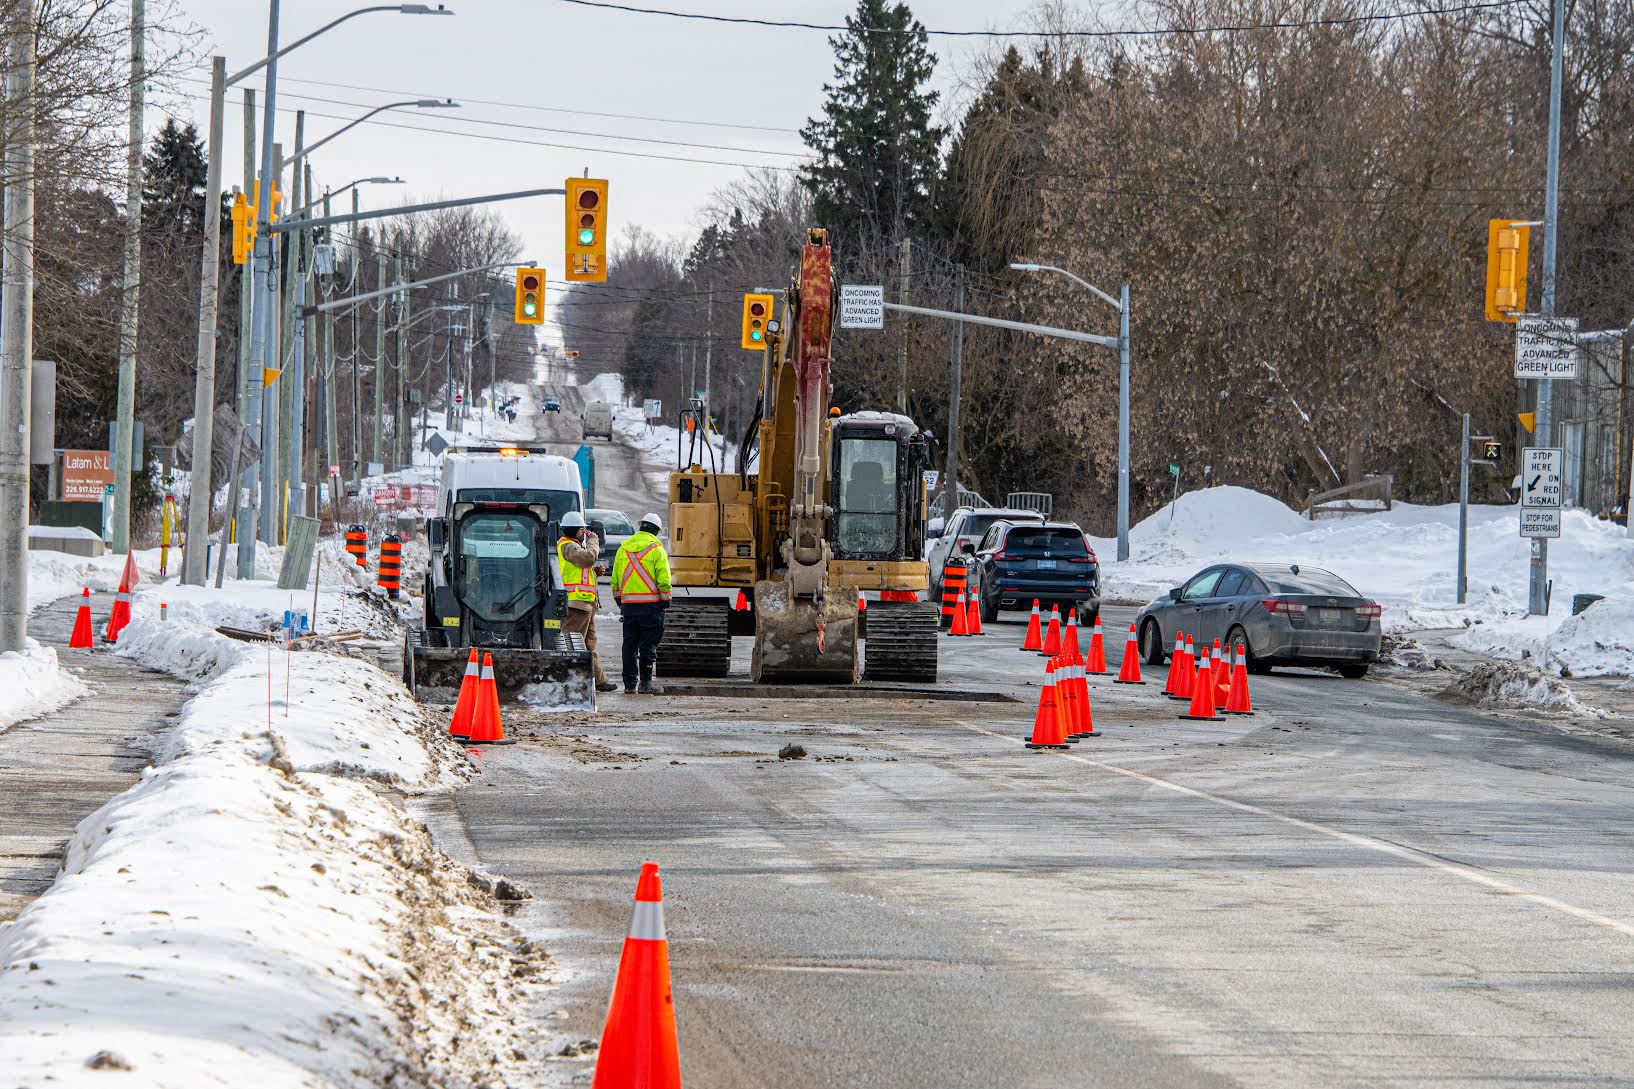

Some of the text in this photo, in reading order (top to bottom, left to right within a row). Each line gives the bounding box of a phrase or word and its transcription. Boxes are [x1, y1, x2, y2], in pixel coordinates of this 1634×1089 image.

[1518, 336, 1555, 346] TRAFFIC
[1522, 350, 1570, 359] ADVANCED
[1517, 362, 1575, 372] GREEN LIGHT
[1532, 452, 1553, 460] STOP
[66, 455, 92, 469] Latam
[93, 455, 103, 470] &
[1531, 463, 1552, 471] HERE
[1548, 475, 1559, 483] ON
[1543, 486, 1559, 494] RED
[1528, 496, 1557, 505] SIGNAL
[1526, 514, 1553, 522] STOP FOR
[1521, 524, 1559, 532] PEDESTRIANS
